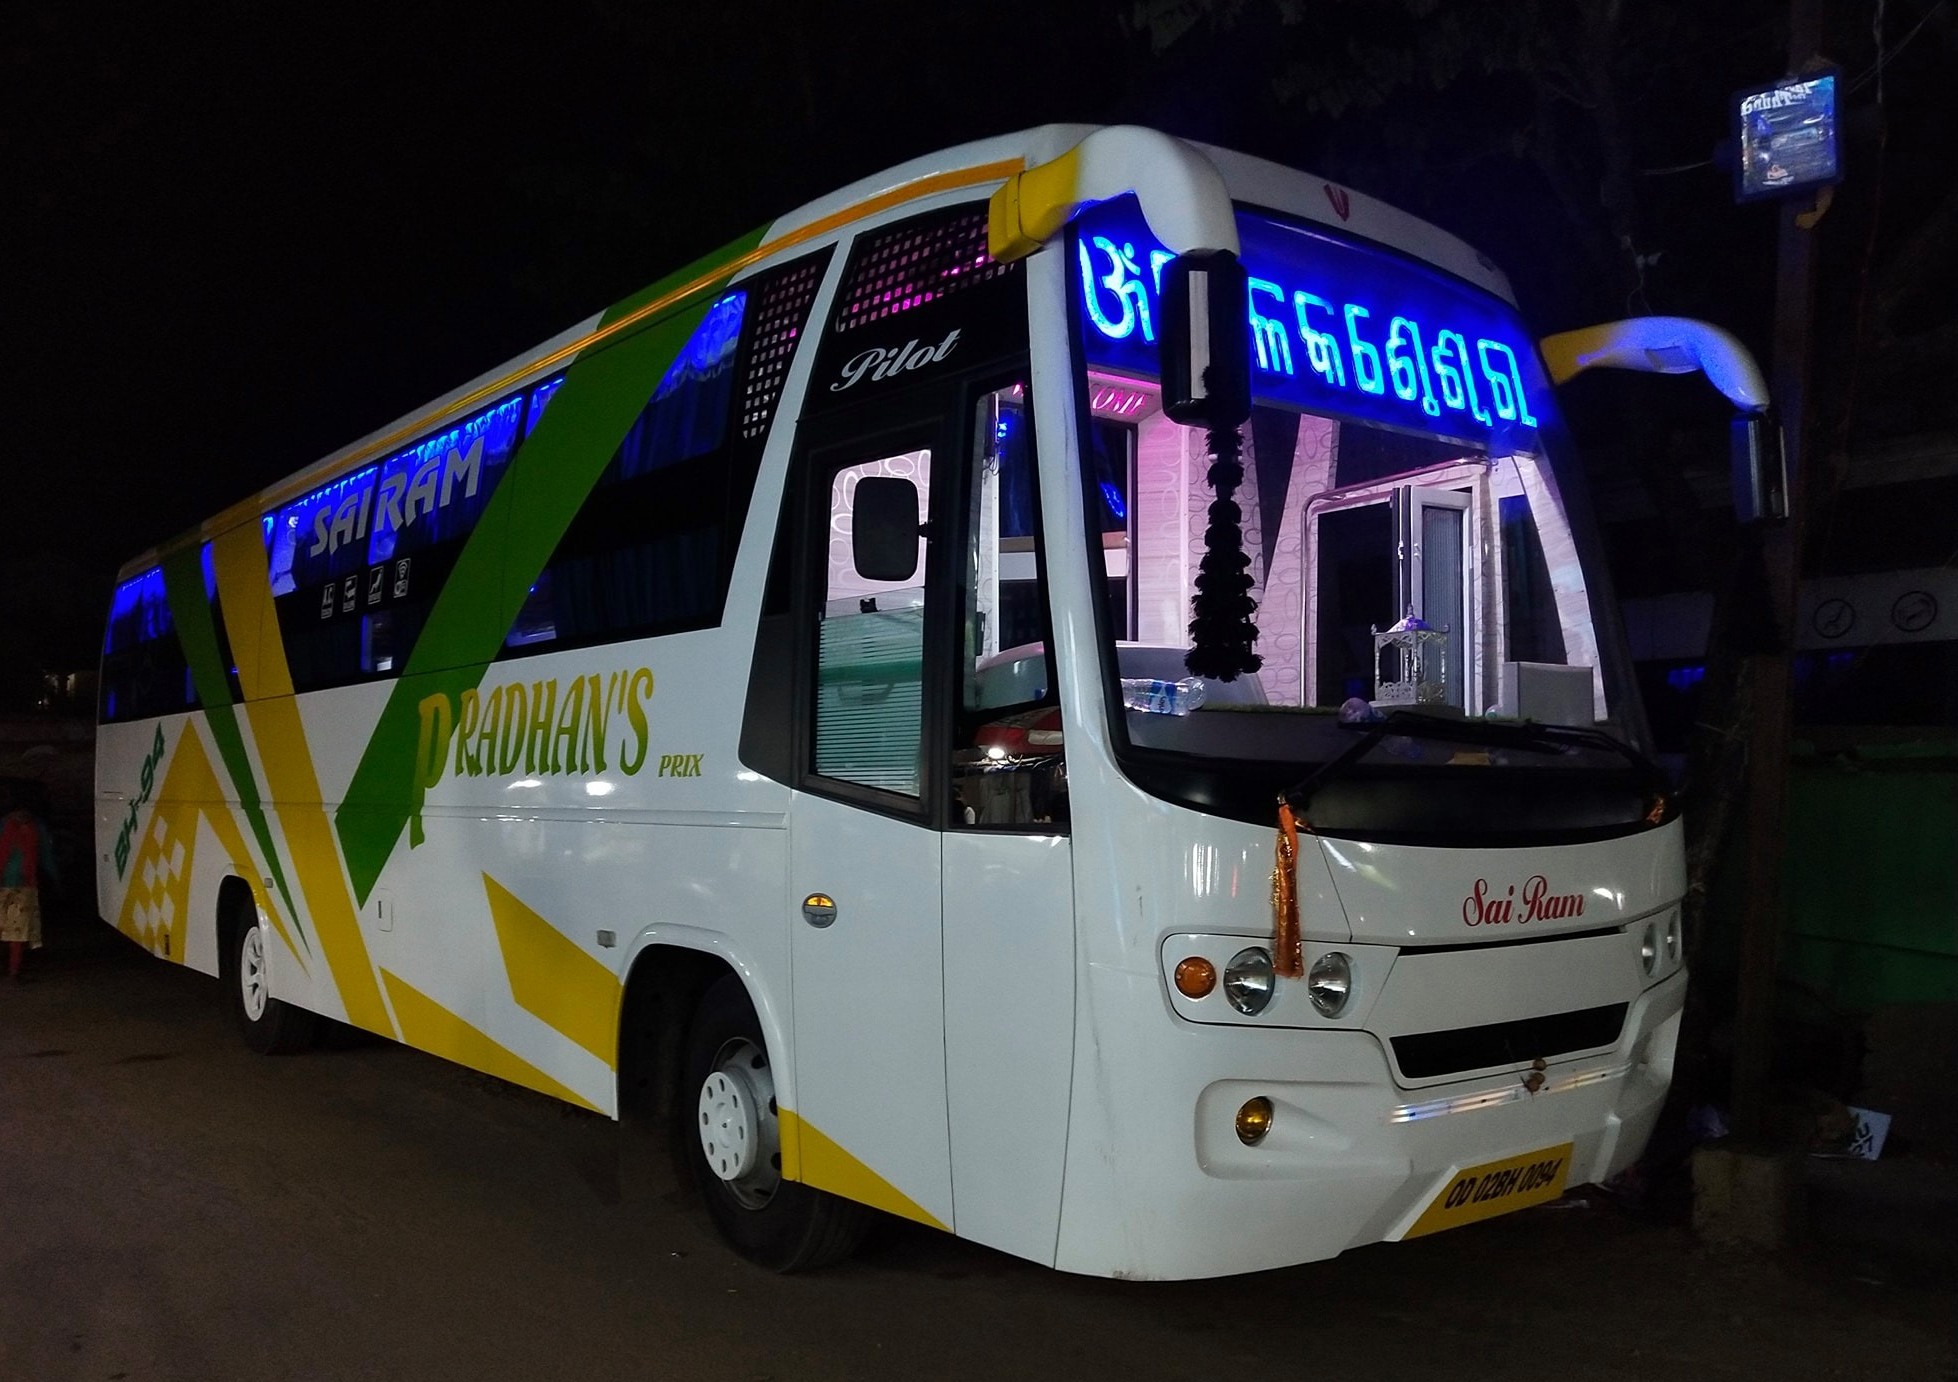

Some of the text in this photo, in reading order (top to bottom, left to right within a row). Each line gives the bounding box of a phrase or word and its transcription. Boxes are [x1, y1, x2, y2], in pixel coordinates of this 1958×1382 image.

[829, 328, 962, 392] Pilot
[310, 434, 485, 558] SAI RAM
[409, 667, 705, 851] PRADHAN'S PRIX
[1462, 874, 1585, 927] Sai Ram
[1443, 1157, 1564, 1210] OD 02BH 0094
